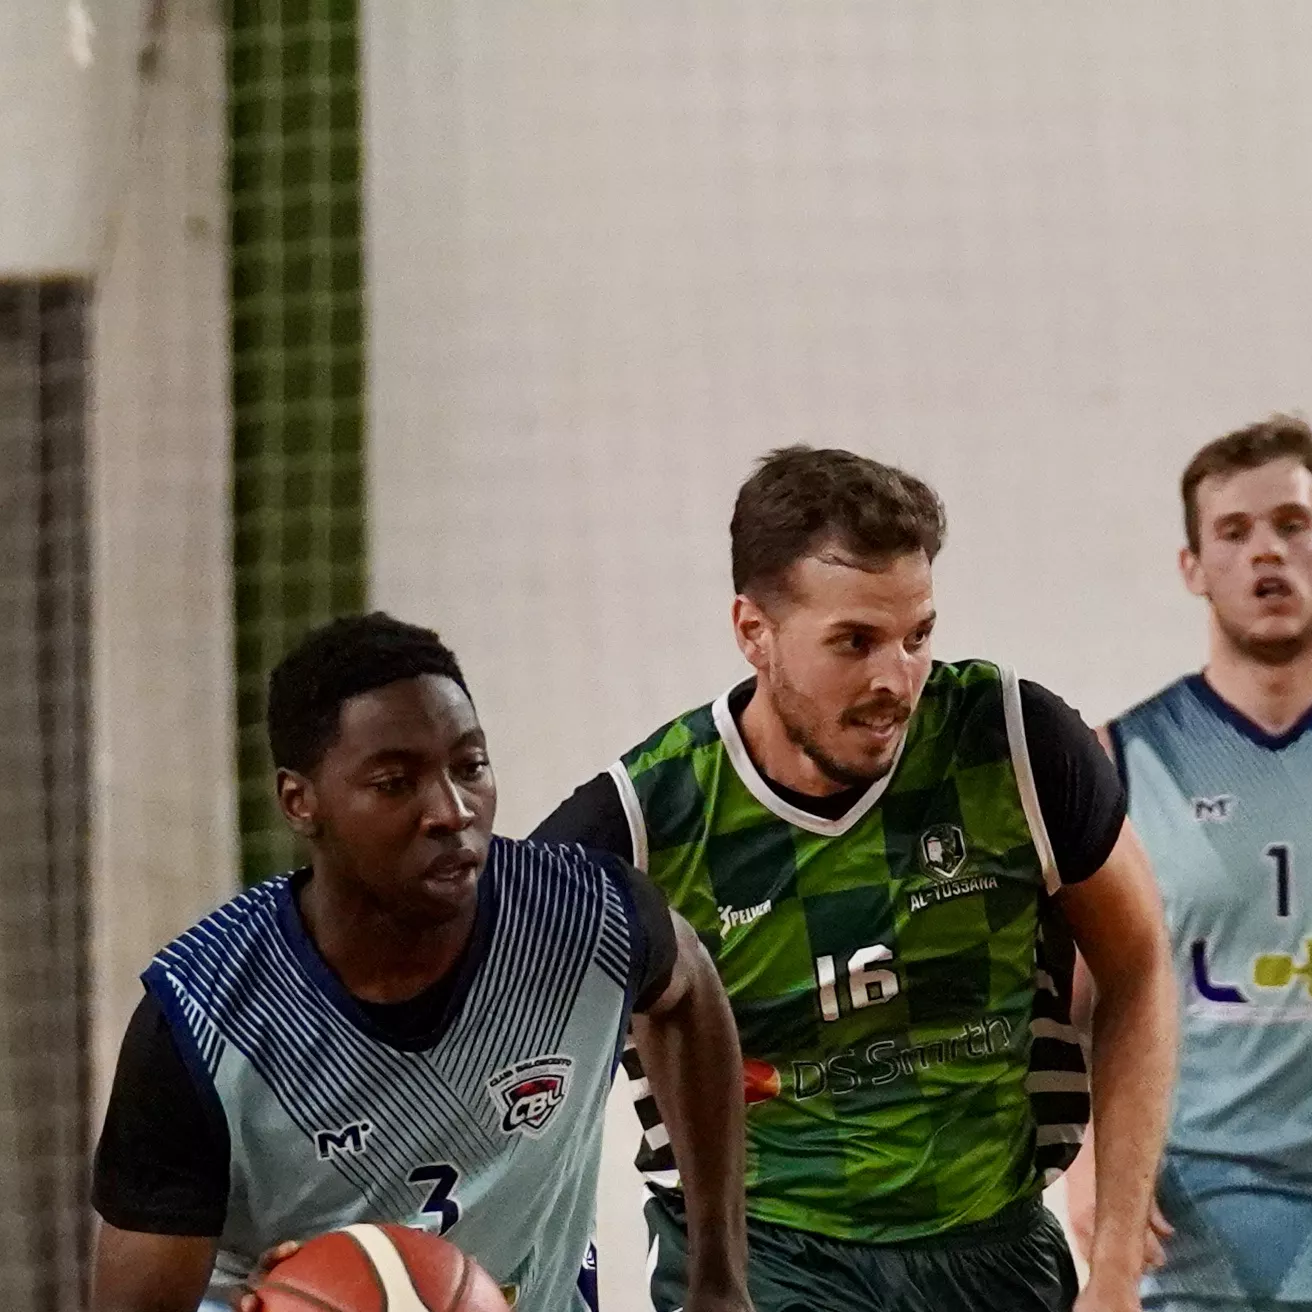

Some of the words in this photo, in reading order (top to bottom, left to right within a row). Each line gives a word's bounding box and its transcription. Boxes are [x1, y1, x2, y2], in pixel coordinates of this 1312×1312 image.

[1265, 843, 1291, 918] 1
[815, 943, 900, 1022] 16
[791, 1048, 862, 1102] DS
[865, 1014, 1013, 1086] Smith
[407, 1163, 459, 1238] 3
